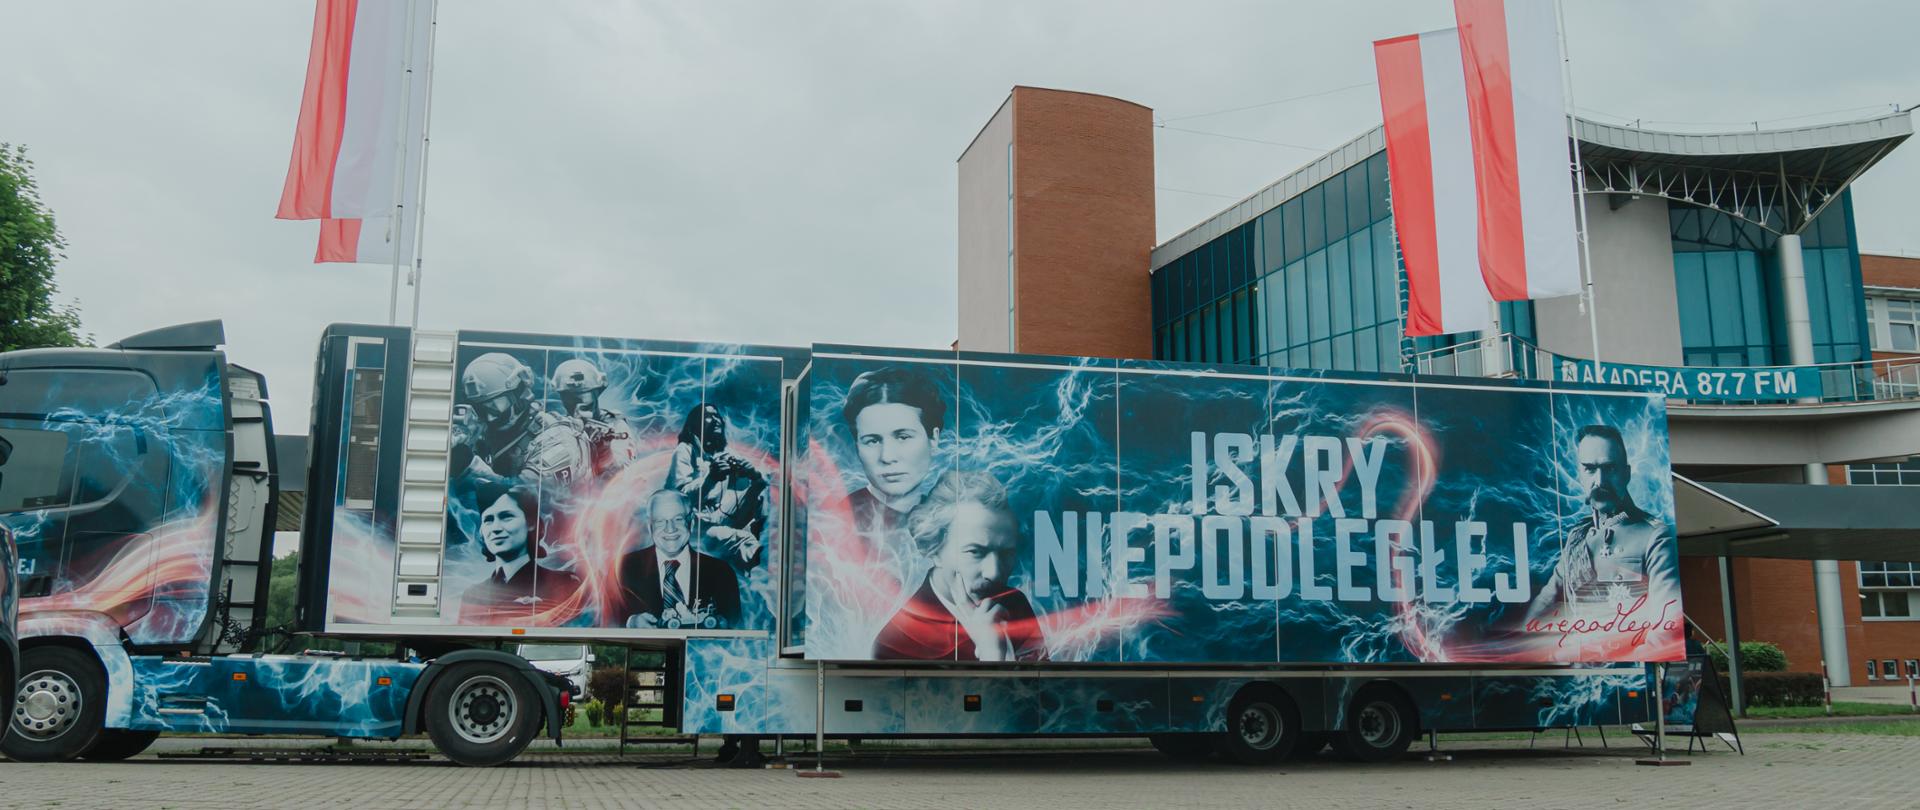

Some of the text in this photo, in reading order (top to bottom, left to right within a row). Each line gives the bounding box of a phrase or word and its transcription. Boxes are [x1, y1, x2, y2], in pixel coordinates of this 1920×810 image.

[1697, 371, 1747, 396] 87.7
[1754, 370, 1797, 395] FM
[1190, 431, 1387, 519] ISKRY
[1033, 510, 1531, 603] NIEPODLEGŁEJ
